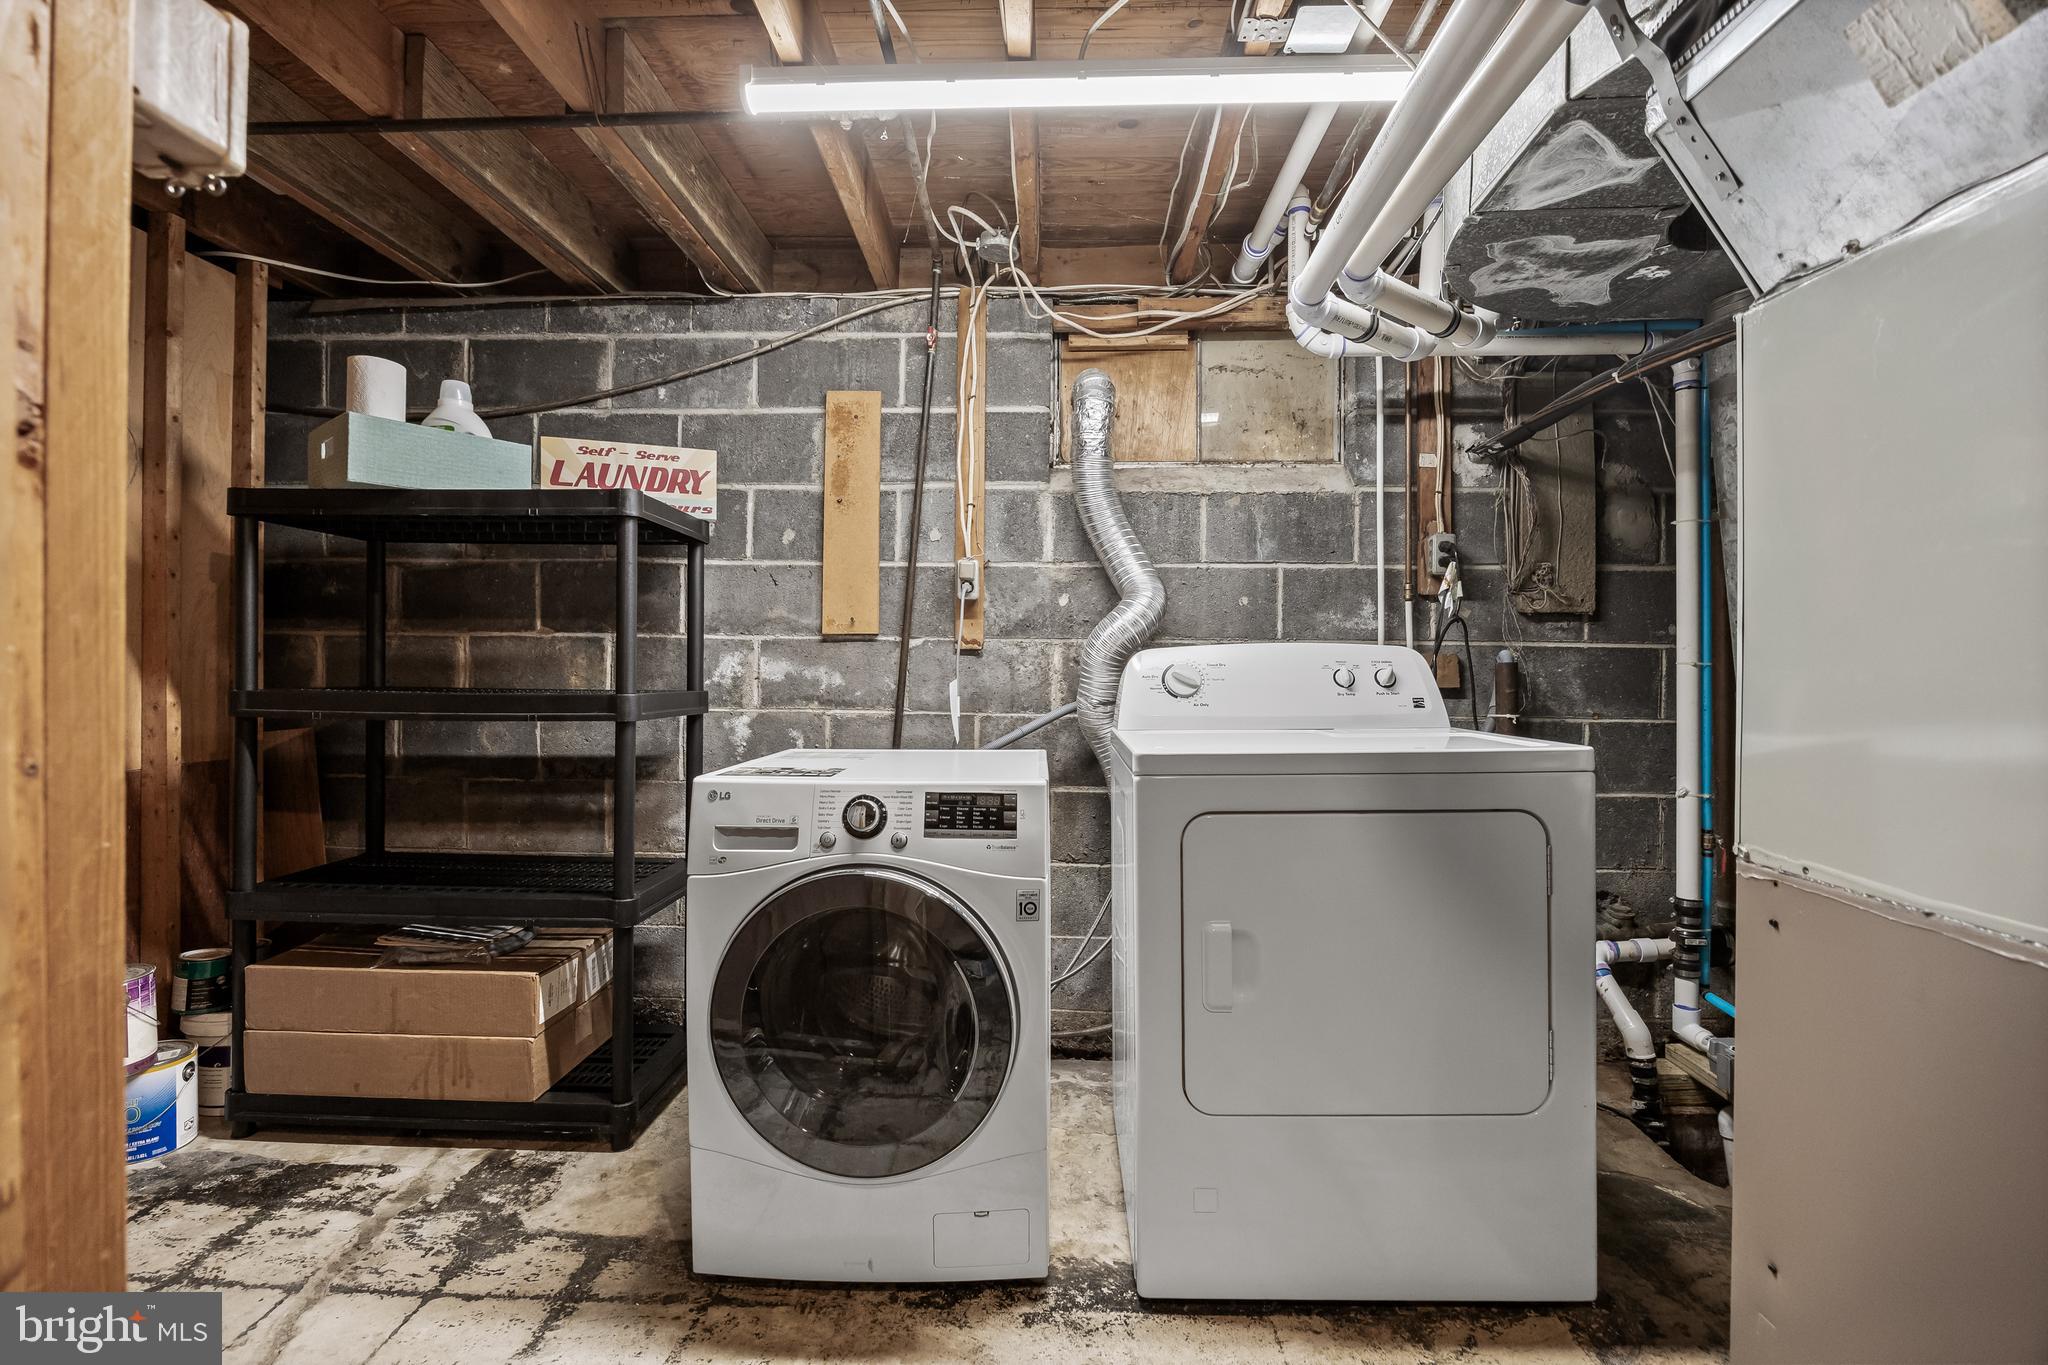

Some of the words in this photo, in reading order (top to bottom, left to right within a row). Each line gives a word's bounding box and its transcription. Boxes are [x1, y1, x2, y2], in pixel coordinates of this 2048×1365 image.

[576, 446, 617, 457] Self
[634, 450, 681, 462] Serve
[549, 460, 711, 495] LAUNDRY
[719, 791, 731, 801] LG
[1018, 901, 1038, 916] 10
